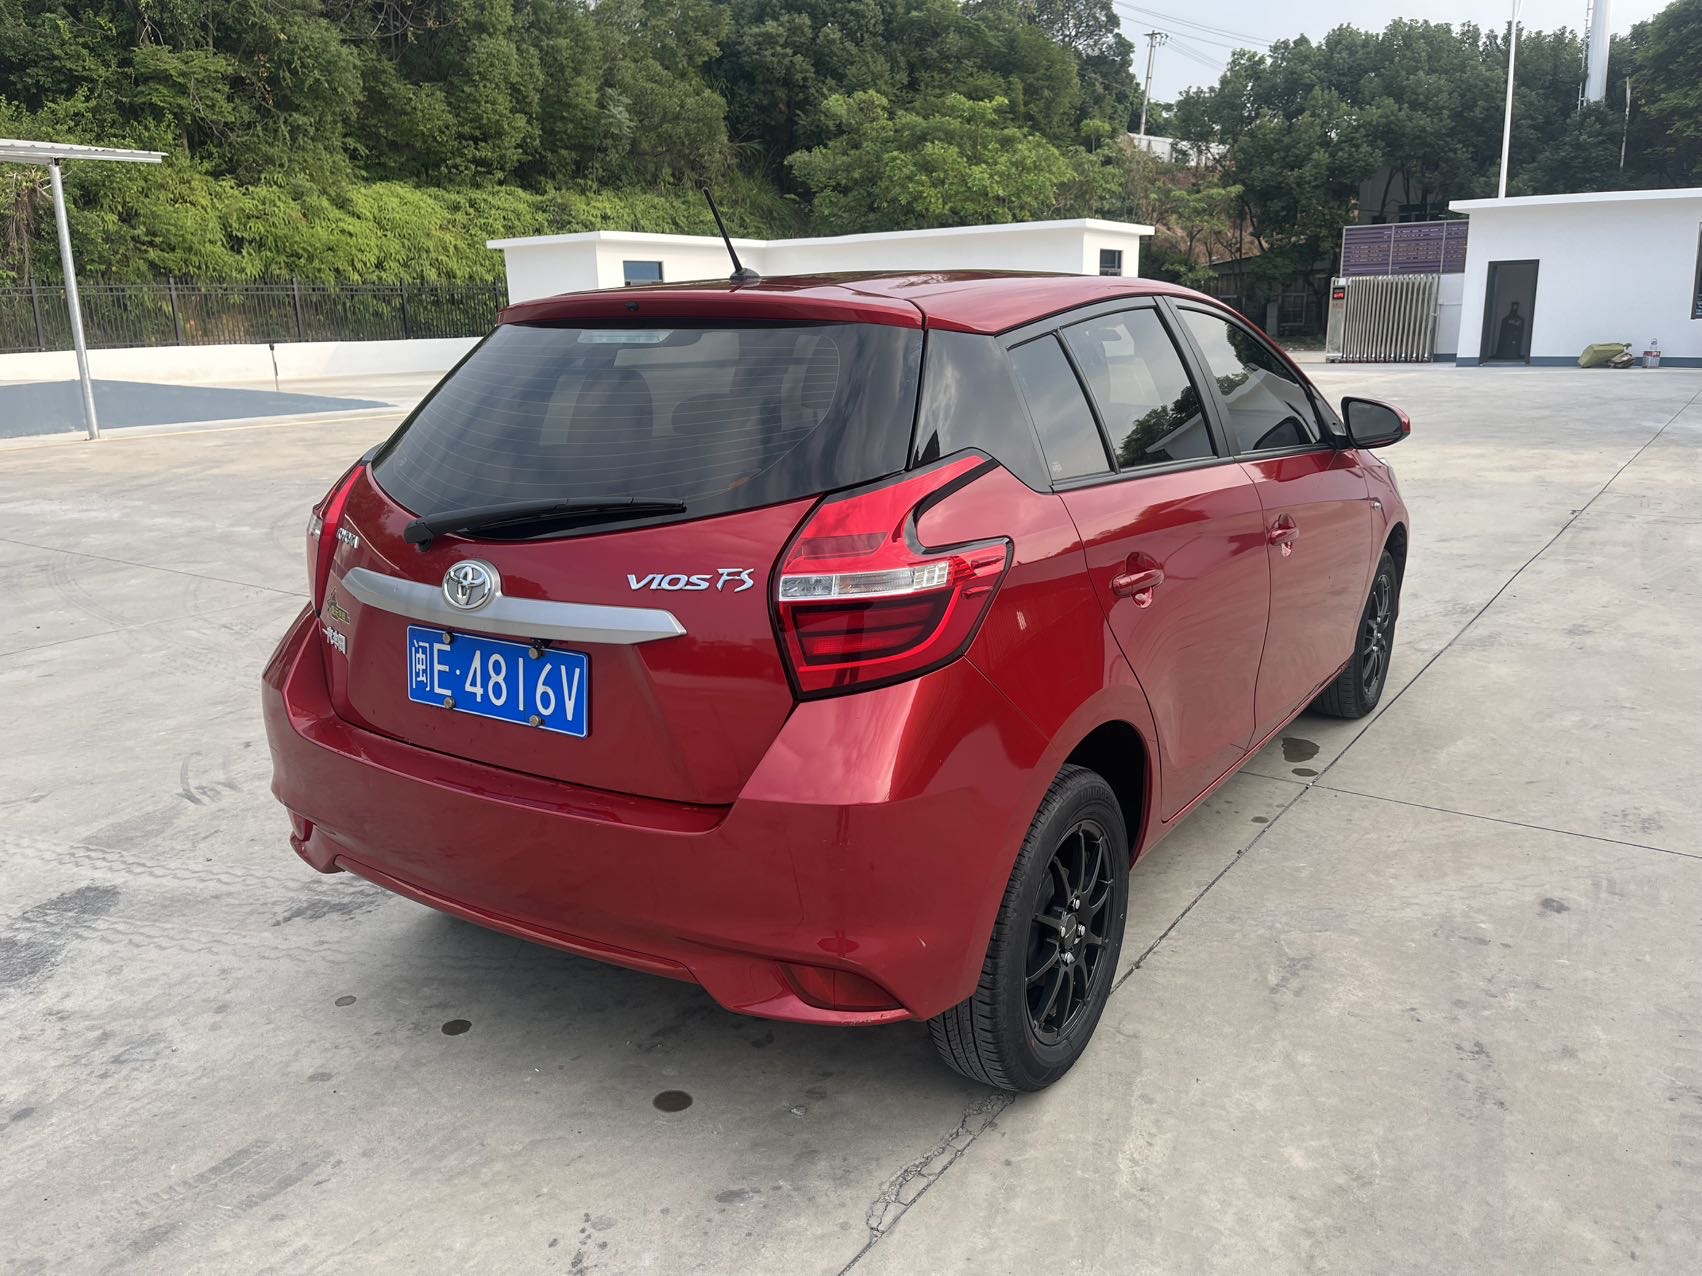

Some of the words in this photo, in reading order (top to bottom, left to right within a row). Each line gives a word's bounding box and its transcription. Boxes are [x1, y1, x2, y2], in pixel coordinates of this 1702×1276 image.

[626, 573, 713, 591] VIOS
[716, 567, 755, 593] FS
[412, 639, 581, 721] 闽E·4816V
